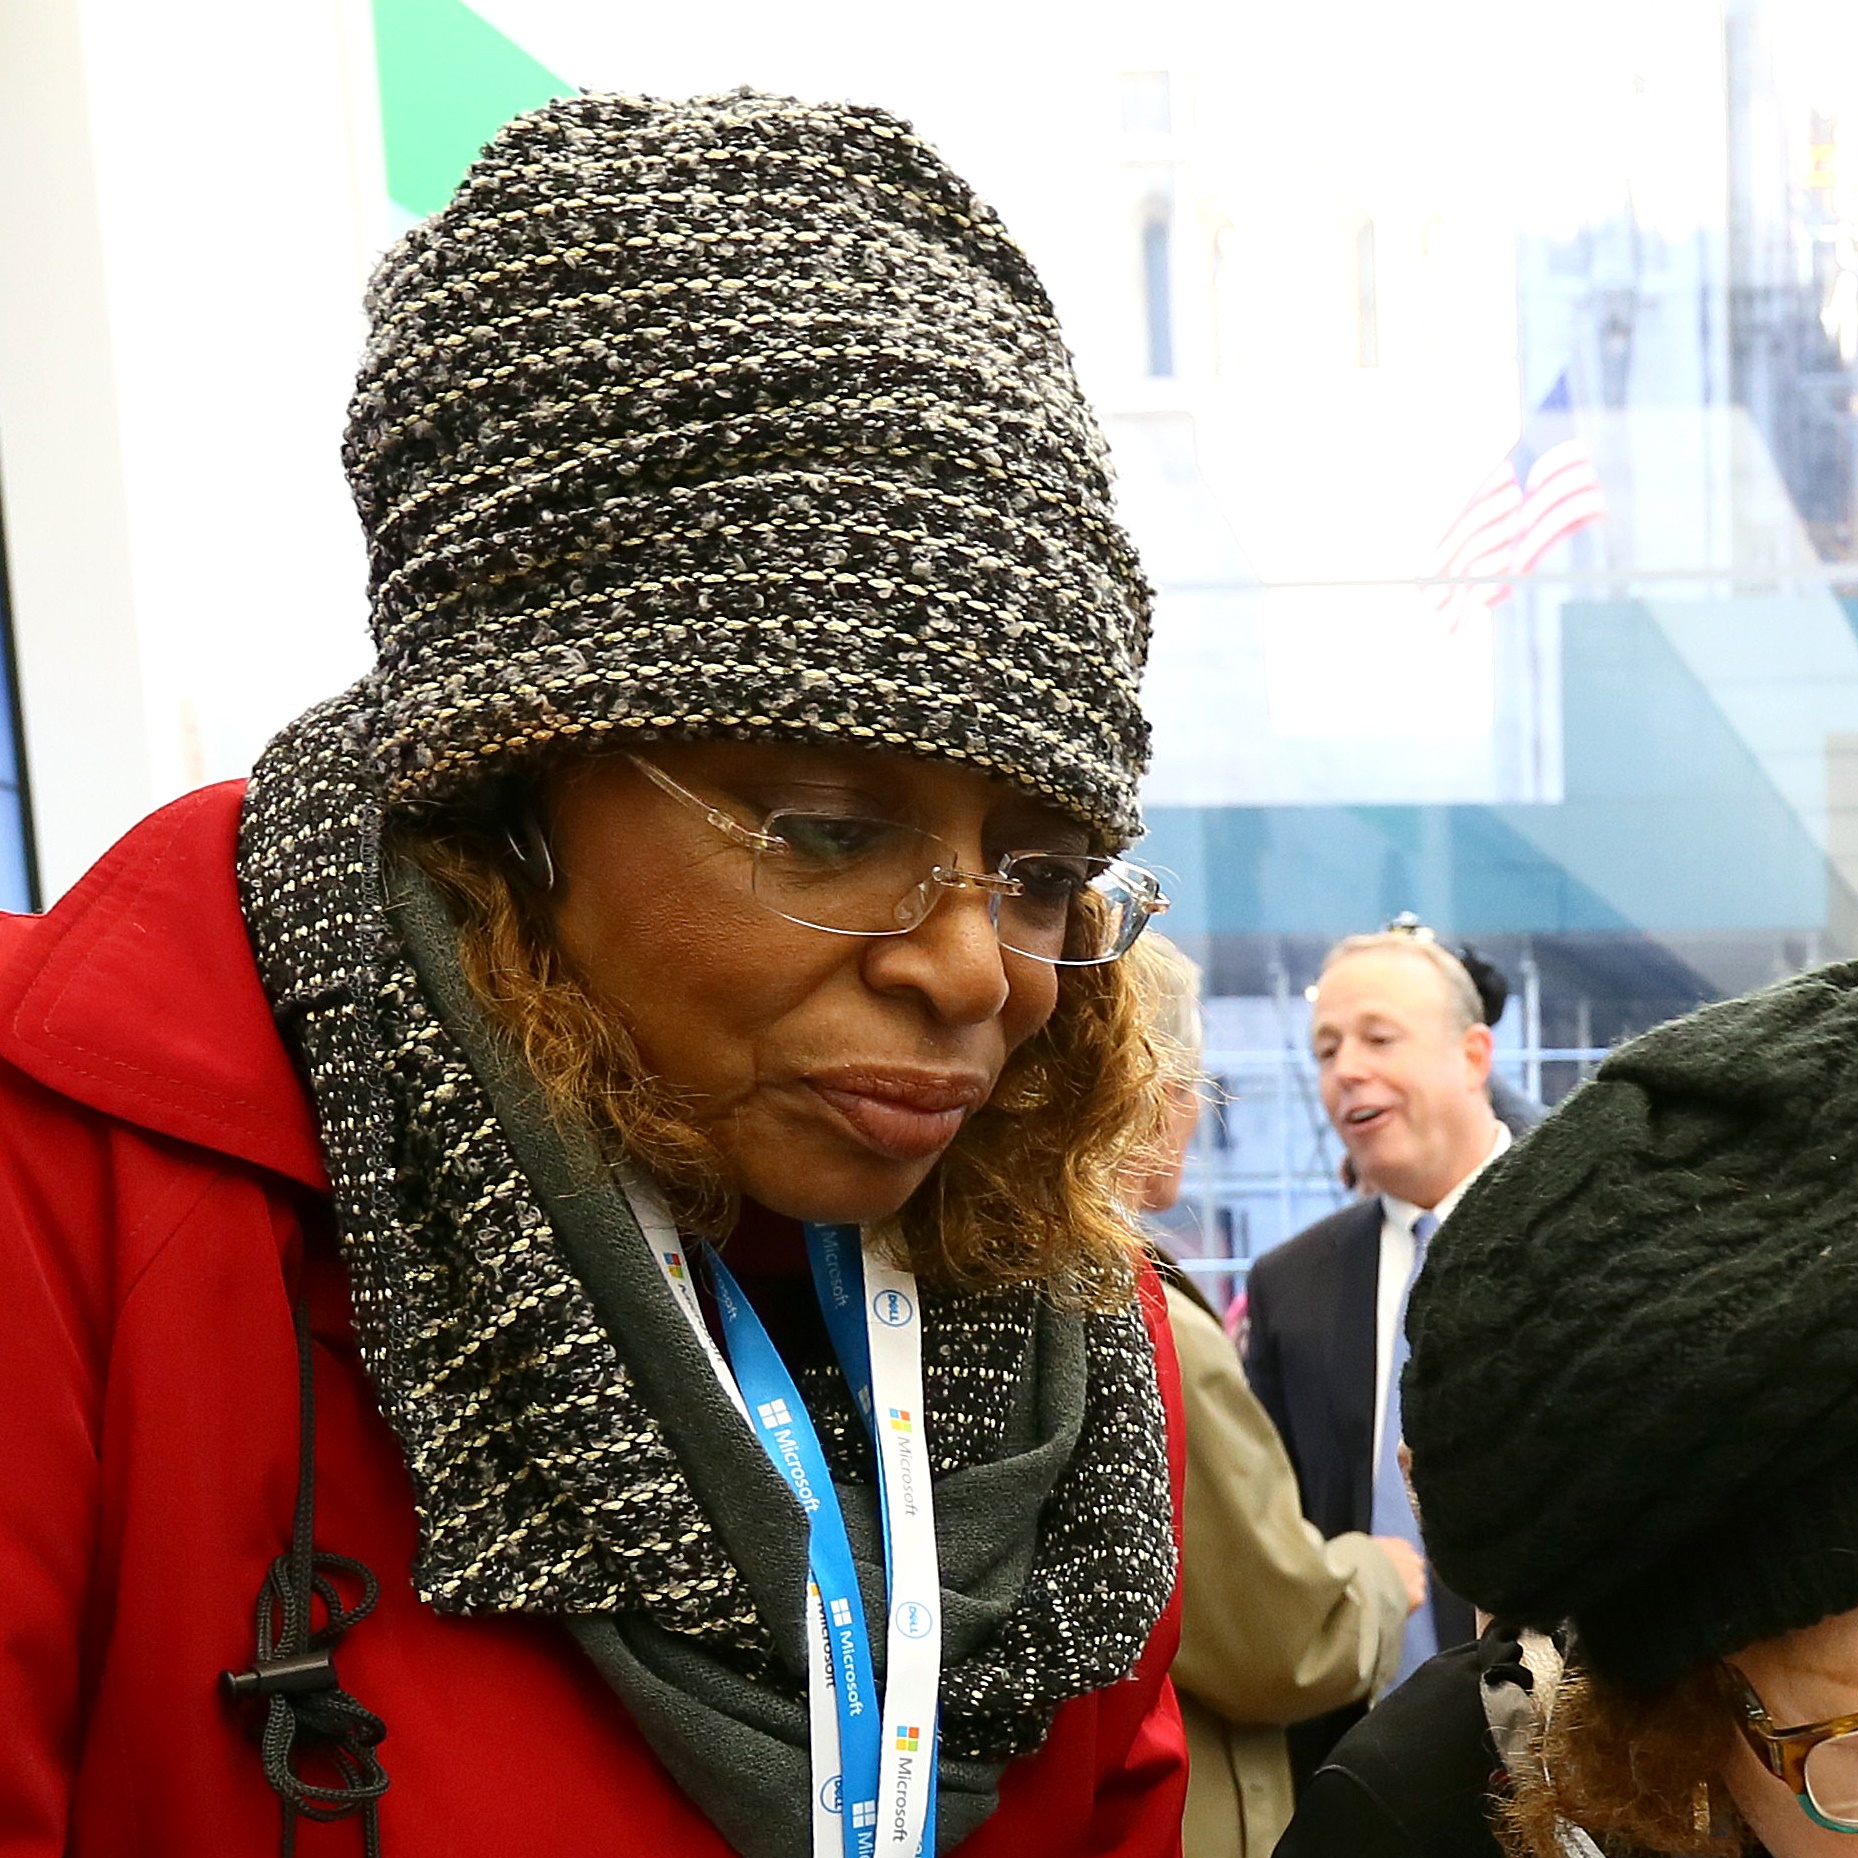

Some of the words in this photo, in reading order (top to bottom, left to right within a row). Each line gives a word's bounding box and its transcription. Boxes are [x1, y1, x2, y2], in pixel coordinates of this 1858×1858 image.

[774, 1428, 821, 1513] Microsoft
[897, 1435, 919, 1517] Microsoft
[840, 1630, 865, 1717] Microsoft
[892, 1756, 913, 1843] Microsoft
